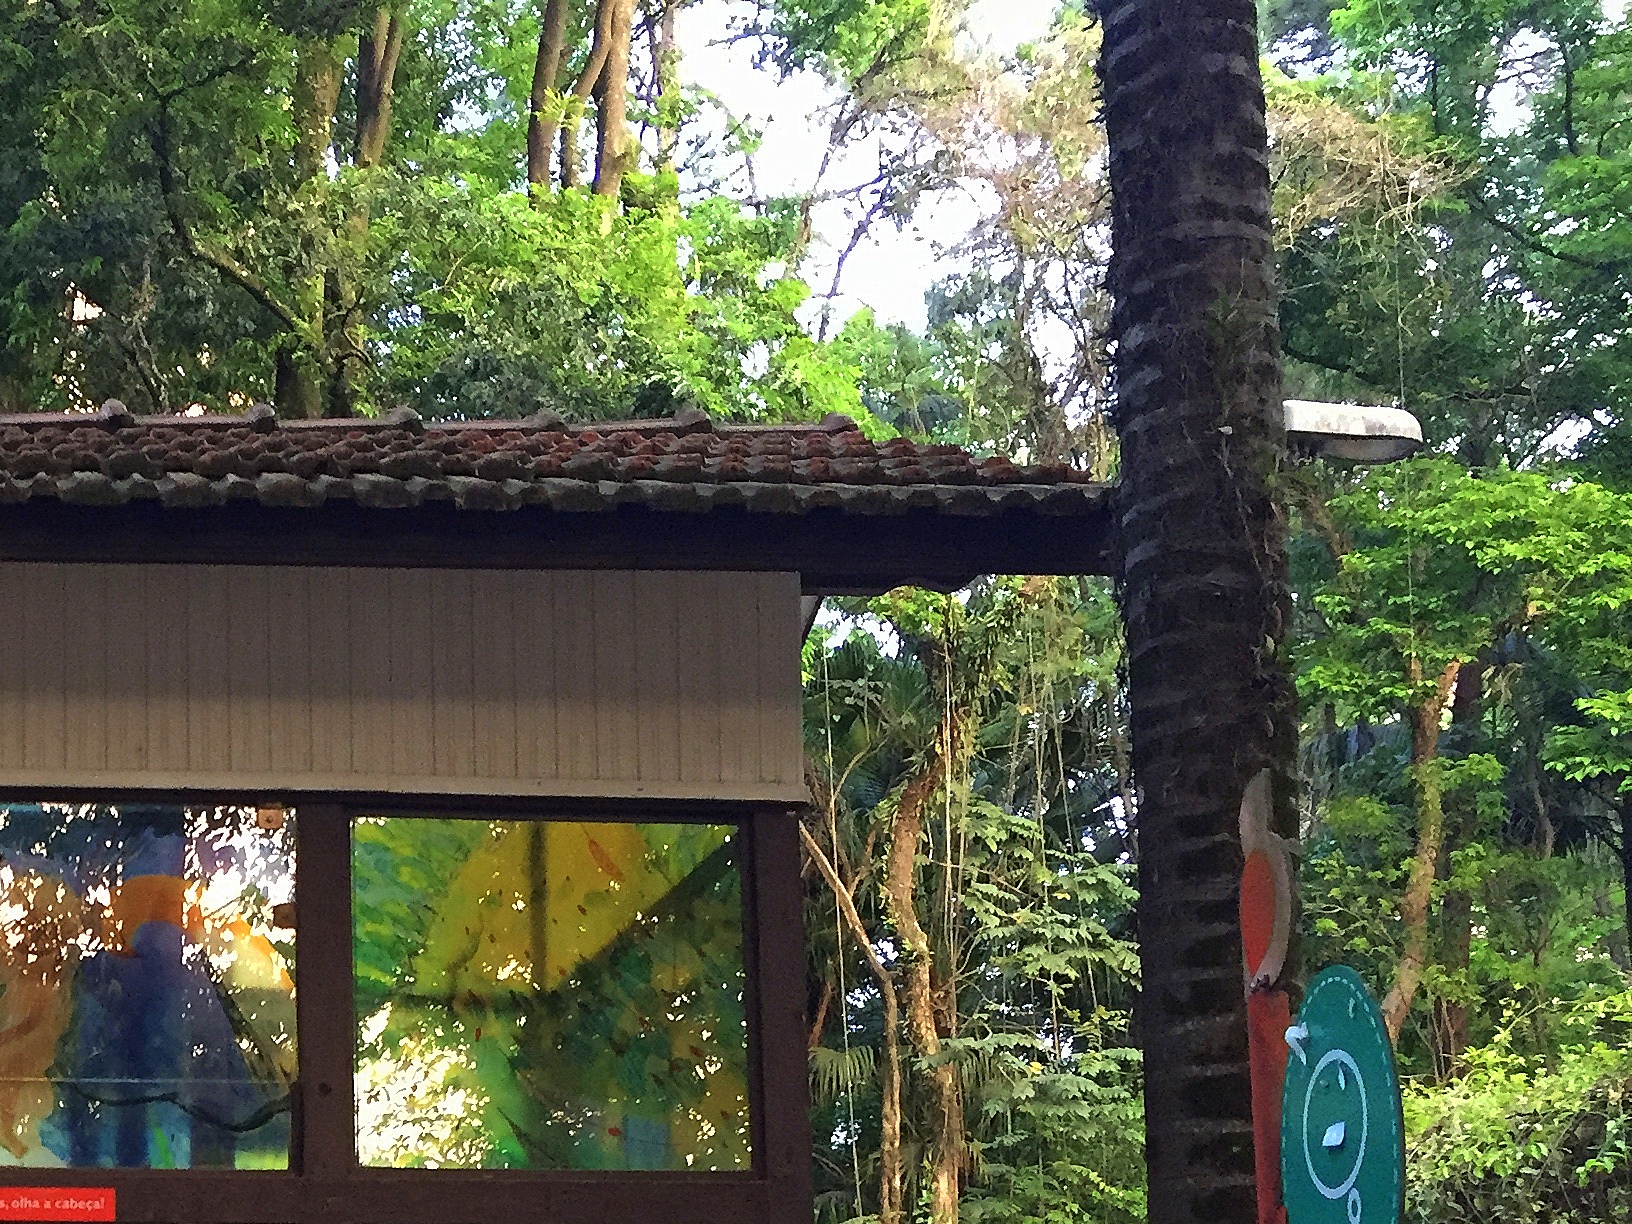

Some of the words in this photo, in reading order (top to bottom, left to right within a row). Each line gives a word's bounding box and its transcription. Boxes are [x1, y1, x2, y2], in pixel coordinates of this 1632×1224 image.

[11, 1198, 40, 1209] olha
[43, 1200, 51, 1209] a
[54, 1198, 105, 1211] cabeça!
